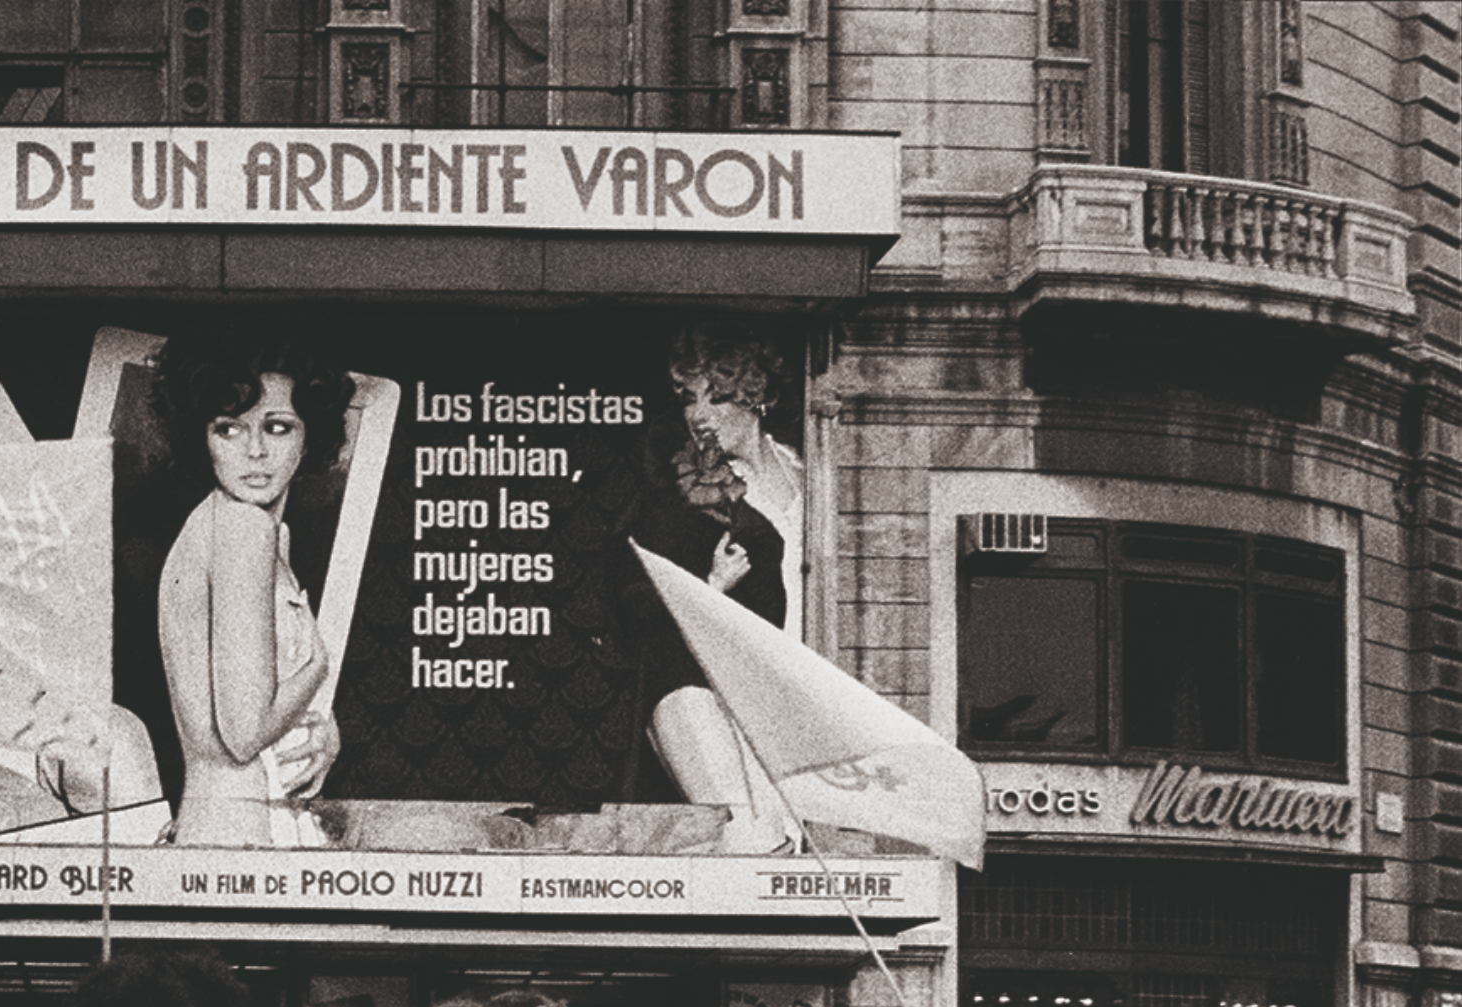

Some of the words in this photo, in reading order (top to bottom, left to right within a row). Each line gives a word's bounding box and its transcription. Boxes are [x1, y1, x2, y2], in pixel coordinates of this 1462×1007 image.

[15, 140, 96, 211] DE
[131, 140, 208, 211] UN
[242, 141, 527, 214] ARDIENTE
[561, 145, 804, 220] VARON
[416, 382, 472, 424] Los
[481, 382, 644, 426] fascistas
[414, 435, 584, 488] prohibian,
[414, 498, 489, 540] pero
[498, 488, 550, 531] las
[412, 541, 555, 593] mujeres
[411, 593, 551, 647] dejaban
[410, 648, 516, 690] hacer.
[59, 864, 135, 896] BLIER
[181, 873, 208, 894] UN
[216, 874, 256, 895] FILM
[264, 875, 288, 896] DE
[300, 869, 396, 897] PAOLO
[408, 871, 484, 898] NUZZI
[520, 878, 686, 900] EASTMANCOLOR
